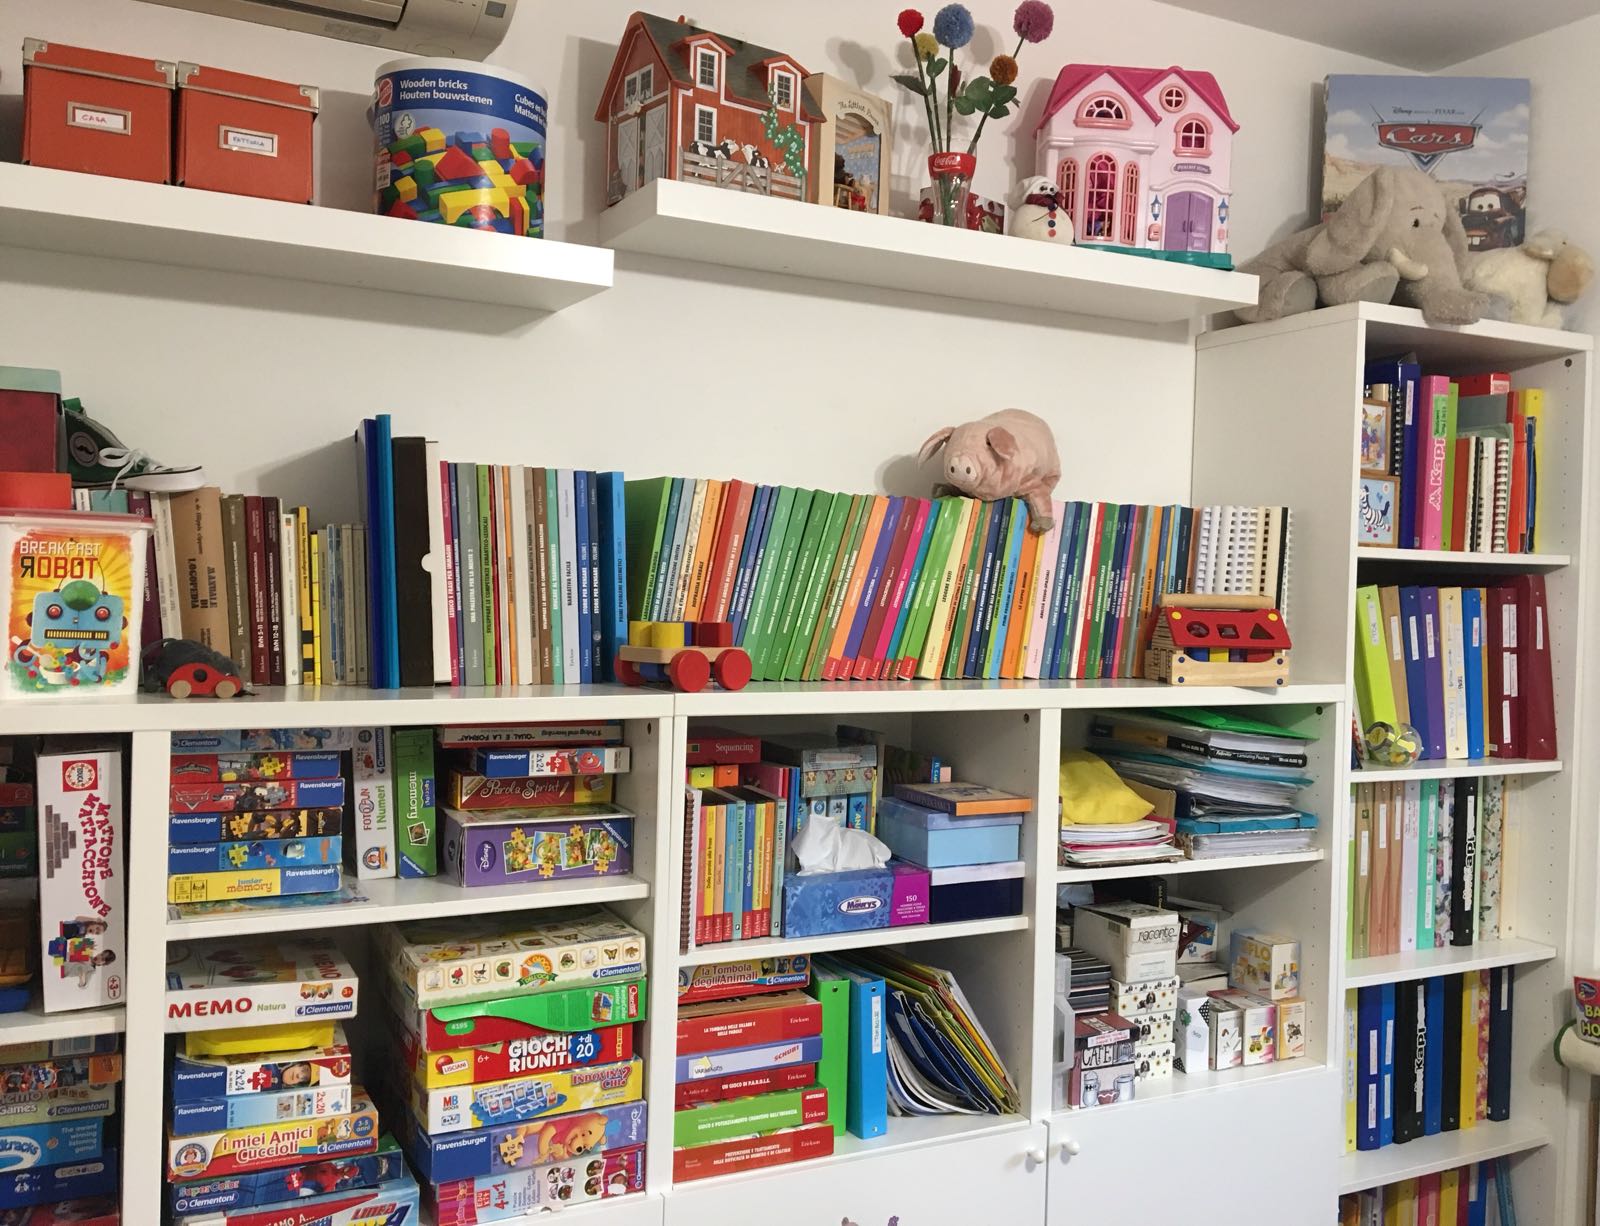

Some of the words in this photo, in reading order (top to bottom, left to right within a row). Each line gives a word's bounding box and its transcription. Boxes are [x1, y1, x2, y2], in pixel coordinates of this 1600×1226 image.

[400, 78, 436, 89] Wooden
[438, 79, 468, 90] bricks
[400, 90, 430, 100] Houten
[433, 90, 492, 106] bouwstenen
[515, 94, 534, 109] Cubes
[1392, 106, 1412, 115] Disney
[81, 114, 107, 124] CASA
[1386, 126, 1464, 144] Cars
[20, 541, 101, 555] BREAKFAST
[187, 558, 199, 609] LOGOPEDIA
[941, 583, 949, 602] LEGGERE
[643, 588, 652, 619] LABORATORIO
[716, 743, 754, 752] Sequencing
[536, 753, 544, 773] 2x24
[407, 772, 417, 819] memory
[480, 780, 520, 797] Parola
[522, 780, 560, 798] Sprint
[376, 785, 386, 823] Numeri
[96, 802, 114, 880] MATTONE
[602, 820, 628, 848] Ravensburger
[78, 793, 112, 917] MATTACCHIONE
[170, 846, 216, 854] Ravensburger
[479, 843, 491, 872] Disney
[286, 867, 335, 877] Ravensburger
[226, 882, 273, 894] memory
[600, 964, 640, 976] Clementoni
[702, 968, 710, 976] la
[713, 964, 752, 974] Tombola
[773, 975, 806, 983] Clementoni
[168, 998, 252, 1018] MEMO
[257, 1003, 286, 1011] Natura
[306, 1002, 351, 1014] Clementoni
[576, 1043, 594, 1058] 20
[477, 1054, 489, 1063] 6+
[444, 1061, 467, 1072] LISCIANI
[177, 1071, 223, 1080] Ravensburger
[235, 1069, 245, 1091] 2x24
[572, 1069, 621, 1086] INDOVINA
[315, 1092, 325, 1113] 2x20
[443, 1095, 458, 1106] MB
[57, 1102, 108, 1115] Clementoni
[178, 1104, 224, 1115] Ravensburger
[805, 1111, 826, 1119] Erickson
[629, 1106, 643, 1141] Disney
[232, 1133, 265, 1149] miei
[270, 1126, 312, 1143] Amici
[327, 1138, 372, 1152] Clementoni
[436, 1136, 487, 1151] Ravensburger
[236, 1141, 298, 1163] Cuccioli
[189, 1194, 235, 1207] Clementoni
